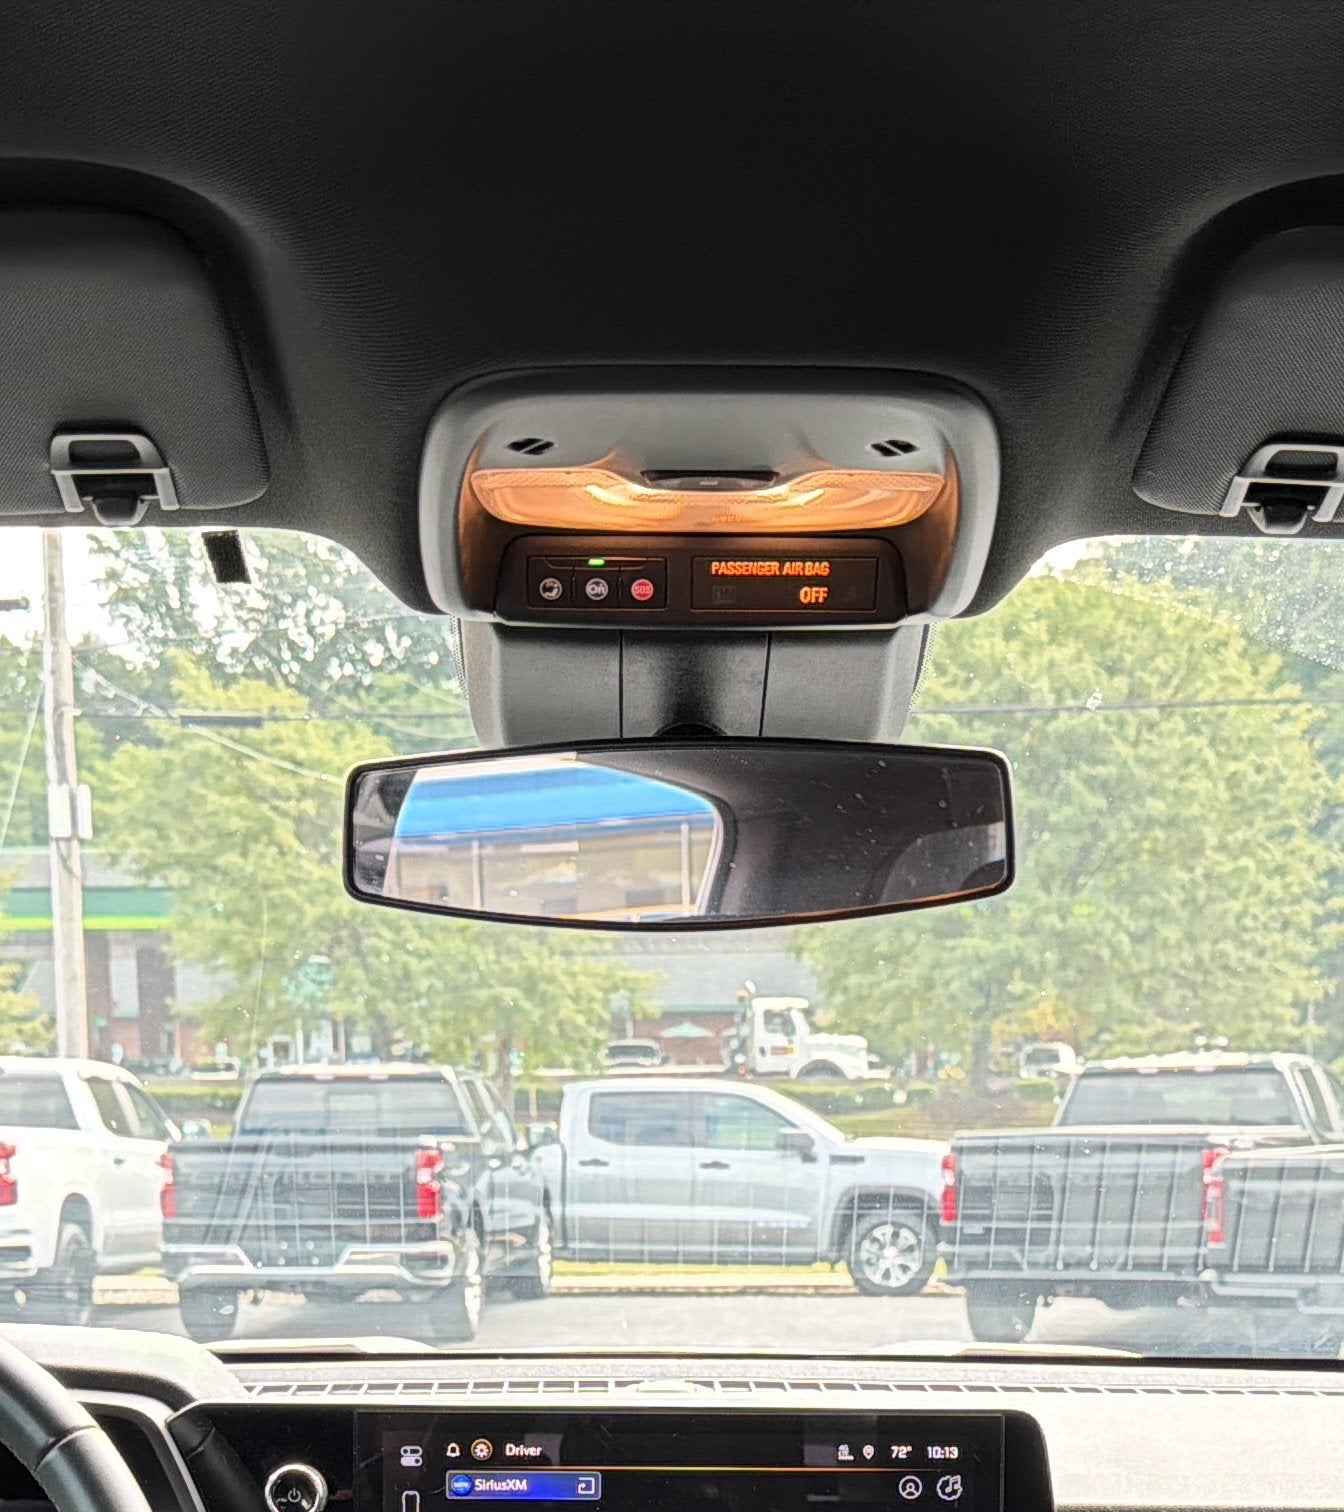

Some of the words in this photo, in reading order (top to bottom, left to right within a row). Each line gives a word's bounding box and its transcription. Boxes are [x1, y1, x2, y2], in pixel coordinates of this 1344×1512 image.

[711, 561, 780, 576] PASSENGER
[782, 561, 803, 576] AIR
[805, 561, 830, 576] BAG
[634, 585, 650, 594] SOS
[799, 586, 829, 604] OFF
[505, 1443, 542, 1457] Driver
[890, 1445, 913, 1459] 72°
[474, 1478, 528, 1491] SiriusXM
